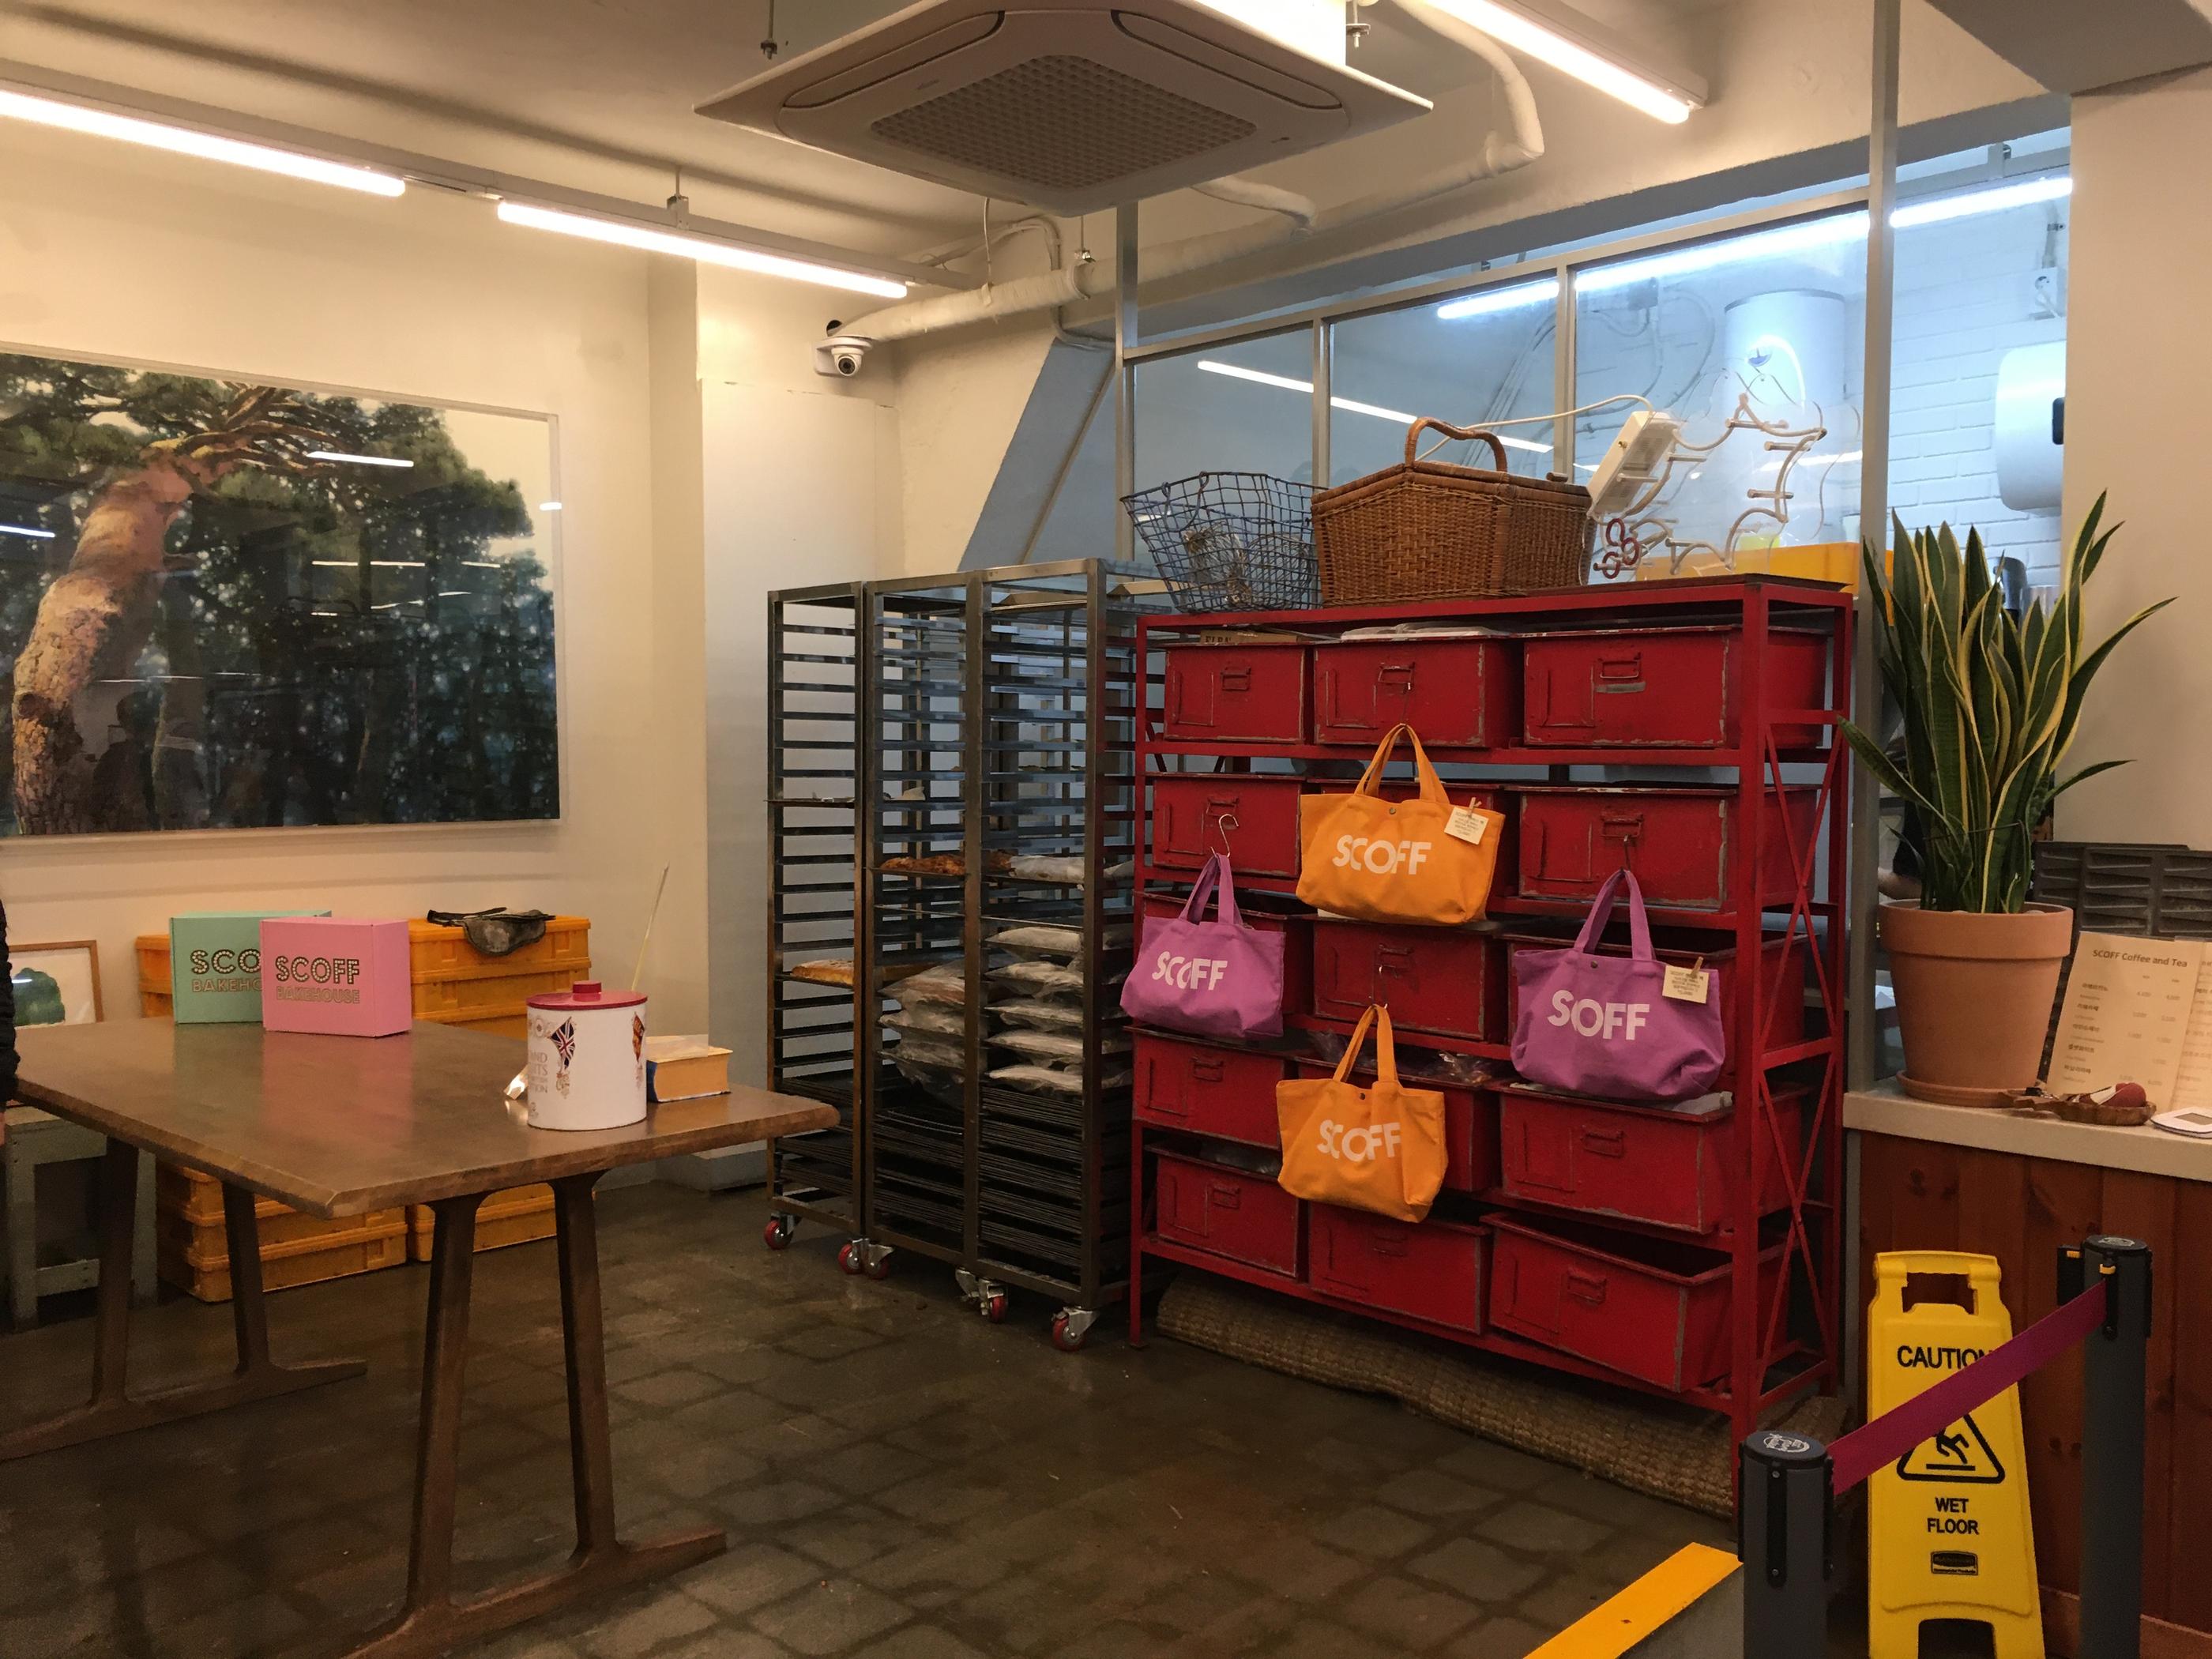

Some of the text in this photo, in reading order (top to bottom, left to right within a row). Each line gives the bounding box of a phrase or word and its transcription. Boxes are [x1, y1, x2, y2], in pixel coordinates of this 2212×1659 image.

[1332, 835, 1431, 875] SCOFF
[275, 955, 359, 985] SCOFF
[1152, 951, 1228, 991] SCOFF
[2093, 950, 2188, 968] SCOFF Coffee and Tea
[276, 986, 360, 1004] BAKEHOUSE
[1316, 1119, 1401, 1163] SCOFF
[1935, 1497, 1969, 1513] WET
[1927, 1518, 1979, 1535] FLOOR
